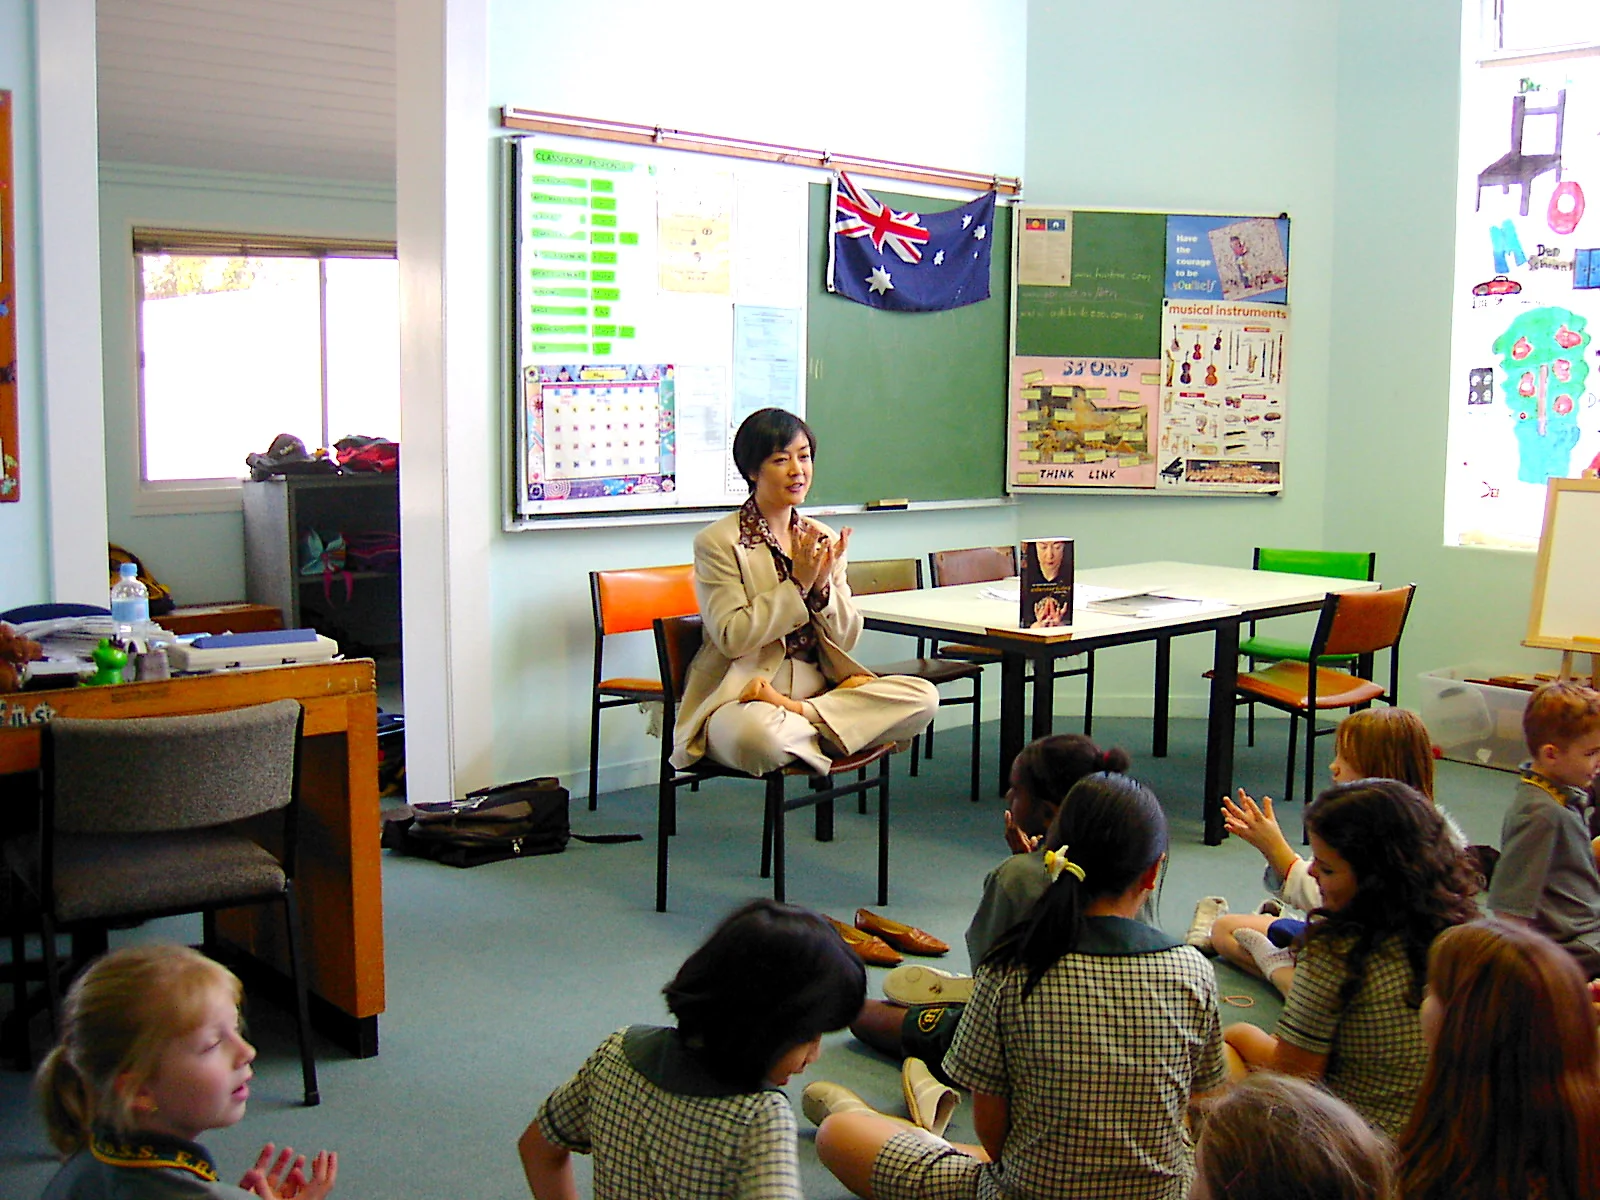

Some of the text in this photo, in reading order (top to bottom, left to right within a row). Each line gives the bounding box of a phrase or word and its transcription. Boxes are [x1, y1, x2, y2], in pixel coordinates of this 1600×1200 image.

[1176, 234, 1198, 243] Have
[1176, 246, 1191, 254] the
[1176, 258, 1211, 267] courage
[1169, 304, 1287, 319] musical instruments
[1063, 360, 1134, 377] SPORT
[1040, 469, 1116, 479] THINK LINK
